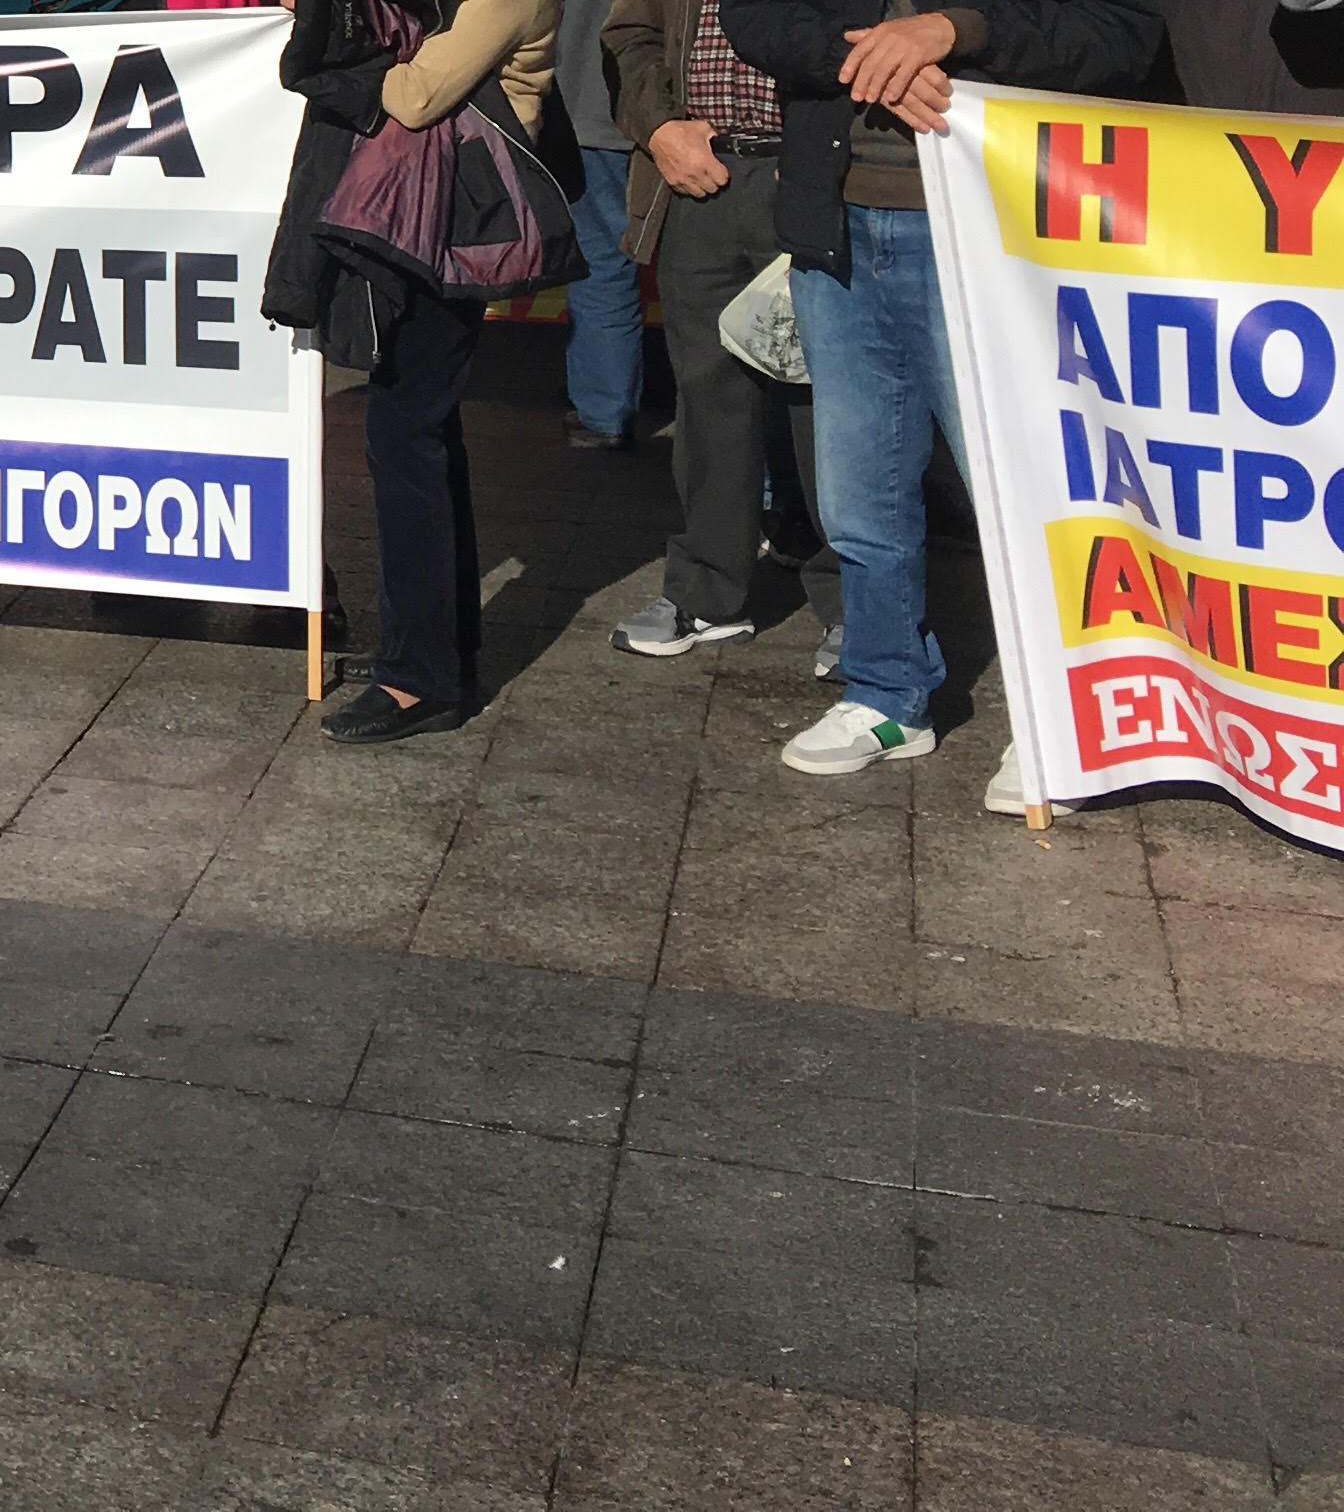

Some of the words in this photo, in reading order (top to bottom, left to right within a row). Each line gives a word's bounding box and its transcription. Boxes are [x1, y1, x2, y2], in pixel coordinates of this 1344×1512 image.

[1035, 121, 1150, 245] Η
[1056, 284, 1337, 427] ΑΠΟ
[1060, 409, 1344, 553] ΙΑΤΡ
[1082, 535, 1344, 691] ΑΜΕ
